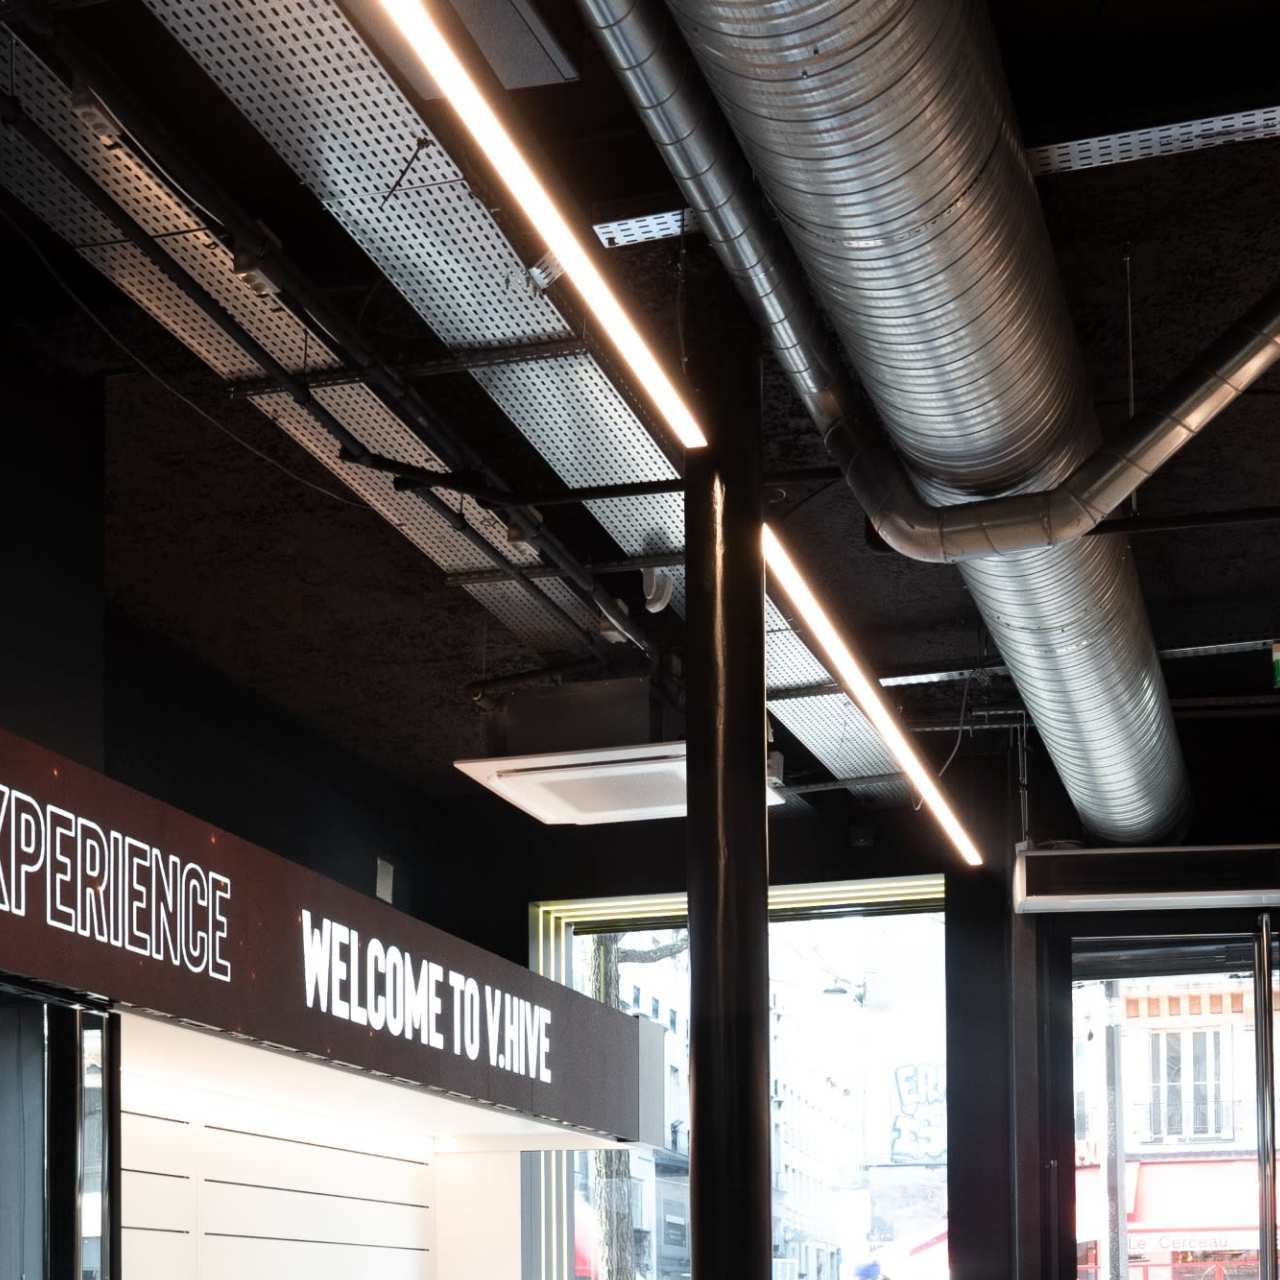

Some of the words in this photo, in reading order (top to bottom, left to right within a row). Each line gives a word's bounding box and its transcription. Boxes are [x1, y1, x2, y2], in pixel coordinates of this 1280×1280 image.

[301, 908, 445, 1050] WELCOME
[448, 969, 481, 1062] TO
[484, 984, 552, 1085] V.HIVE
[1127, 1235, 1146, 1250] Le
[1157, 1234, 1230, 1250] Cerceau
